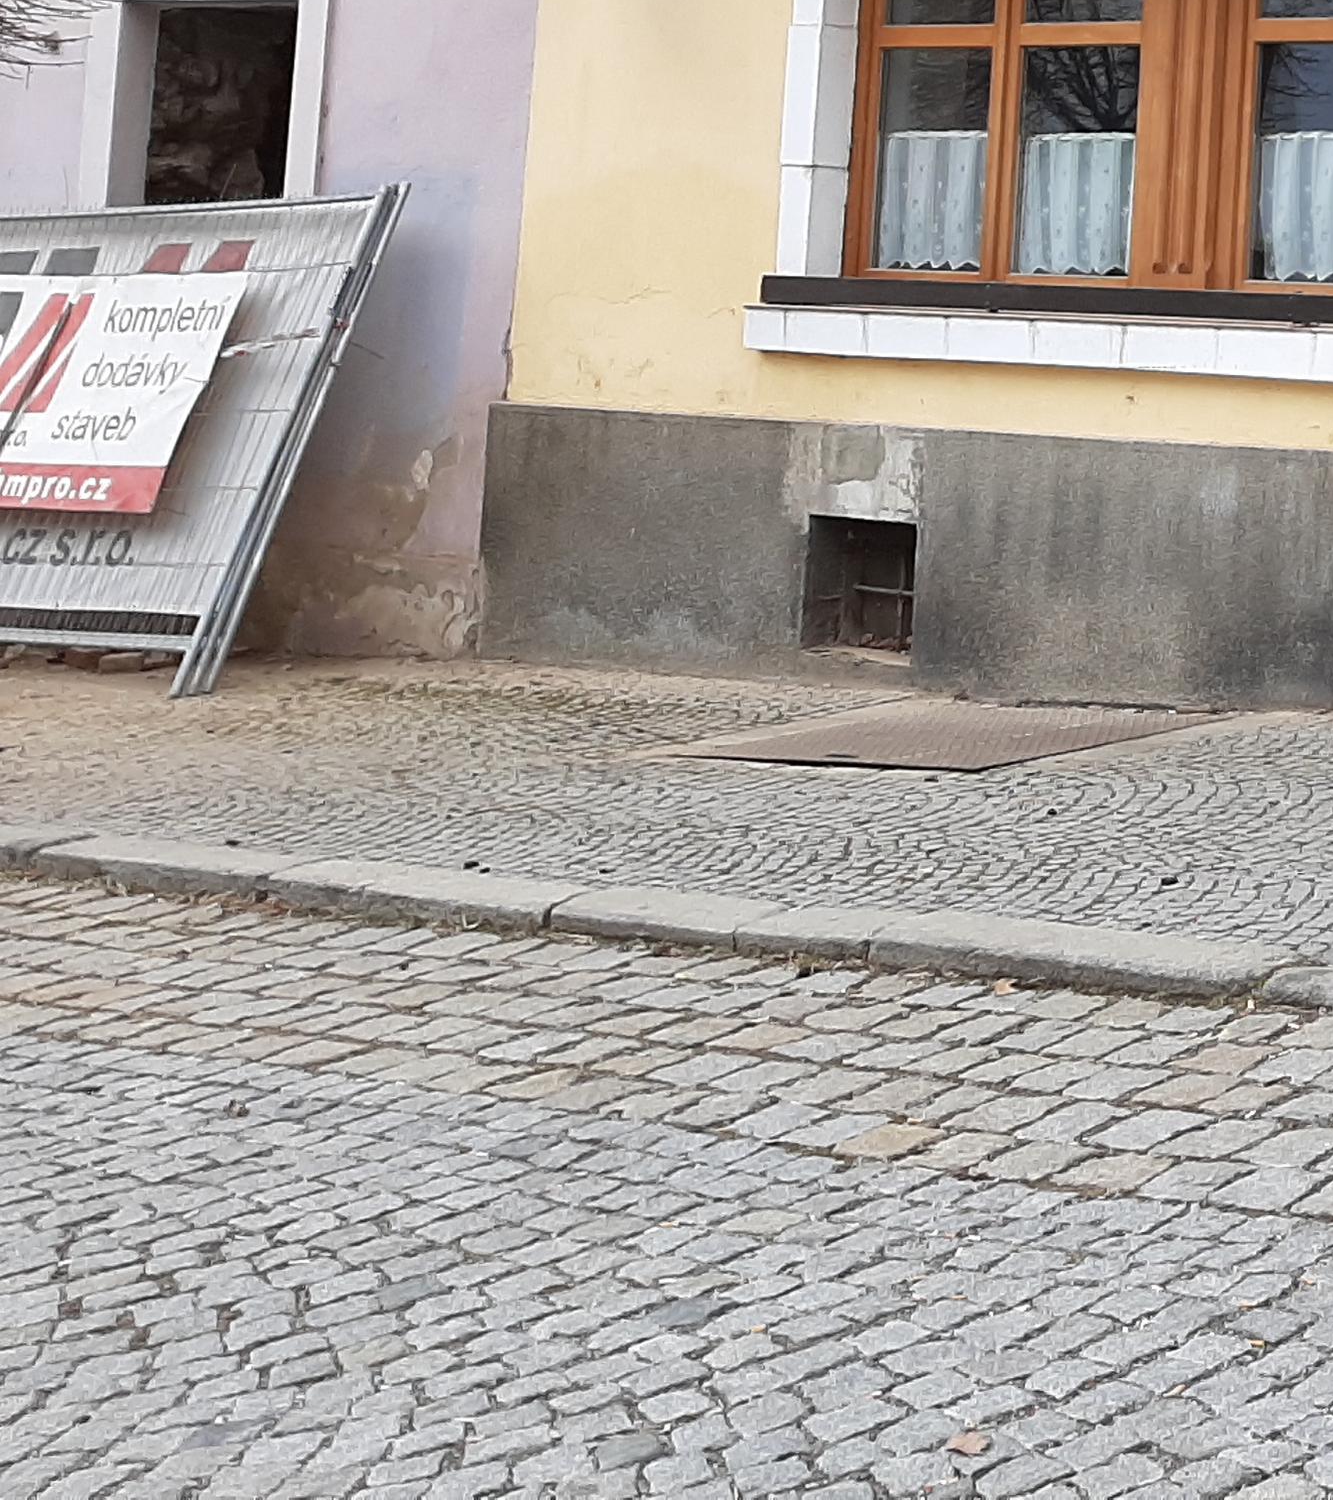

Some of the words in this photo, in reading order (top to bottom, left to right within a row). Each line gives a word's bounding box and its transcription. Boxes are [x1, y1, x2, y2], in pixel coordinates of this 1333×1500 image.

[103, 295, 232, 342] kompletní
[81, 352, 188, 395] dodávky
[50, 406, 137, 442] staveb
[0, 470, 113, 505] mpro.cz
